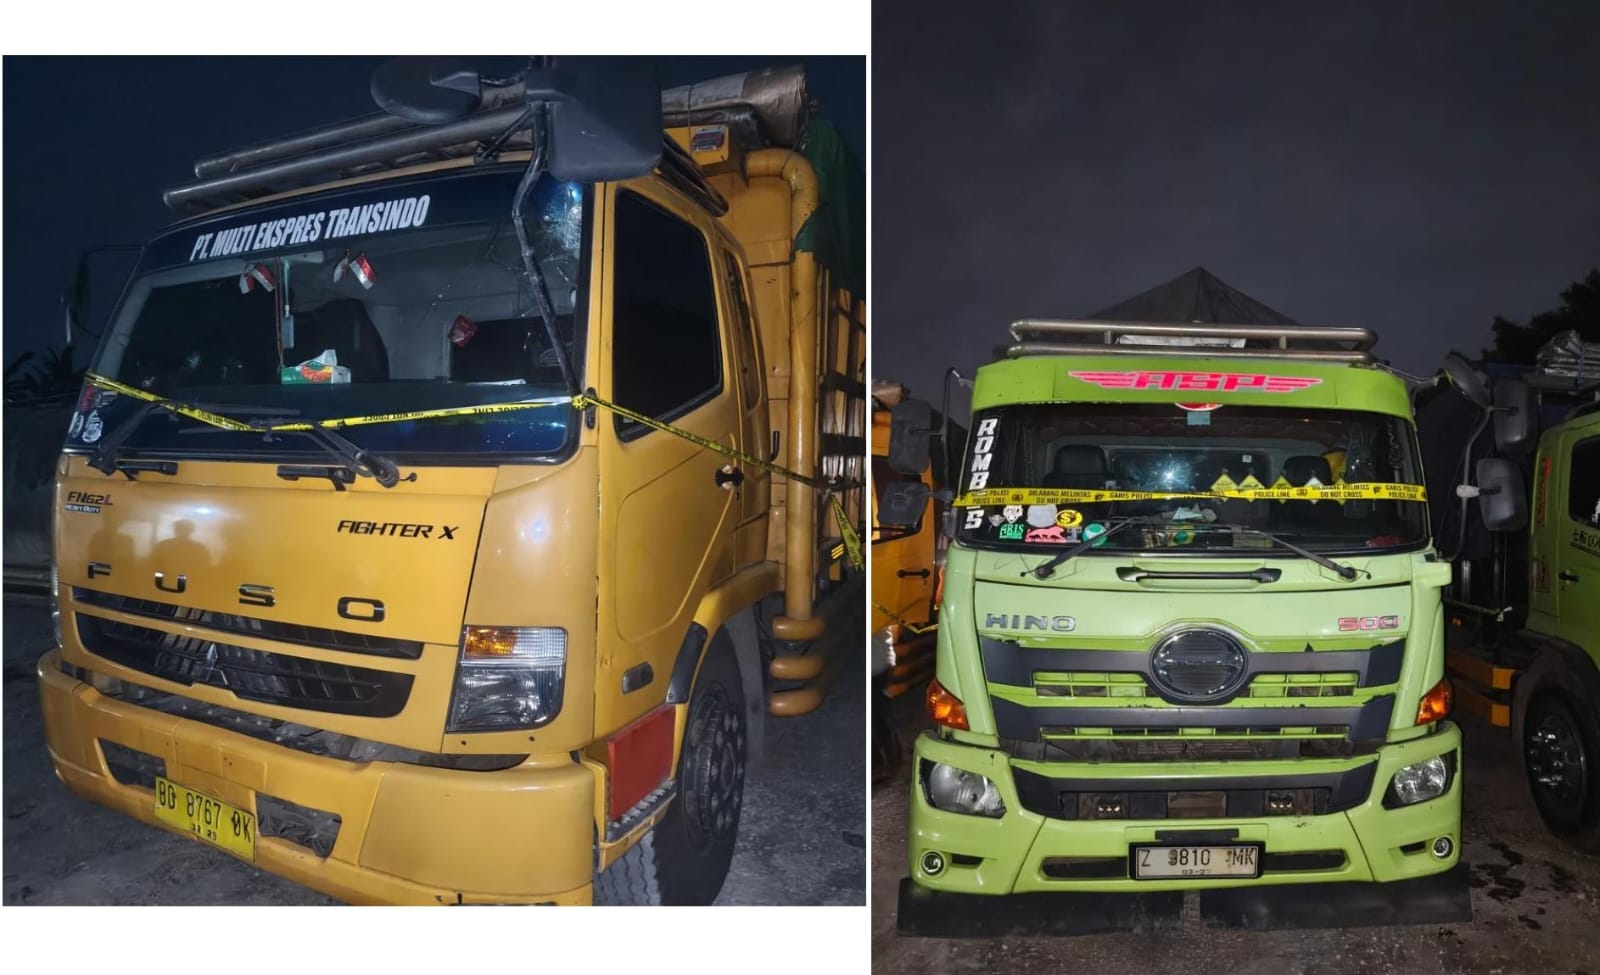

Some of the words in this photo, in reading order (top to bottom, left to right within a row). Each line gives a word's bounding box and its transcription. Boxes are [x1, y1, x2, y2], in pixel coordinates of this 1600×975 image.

[189, 233, 212, 262] PT.
[210, 224, 257, 258] MULTI
[252, 211, 325, 250] EKSPRES
[324, 195, 431, 240] TRANSINDO
[1133, 371, 1266, 393] ASP
[964, 418, 998, 530] ROMBS
[337, 519, 434, 540] FIGHTER
[437, 525, 460, 541] X
[87, 561, 385, 623] FUSO
[985, 612, 1077, 632] HINO
[1337, 614, 1400, 631] 500
[186, 792, 221, 829] 8767
[1141, 849, 1151, 867] Z
[1168, 848, 1211, 866] 9810
[1231, 847, 1255, 866] MK
